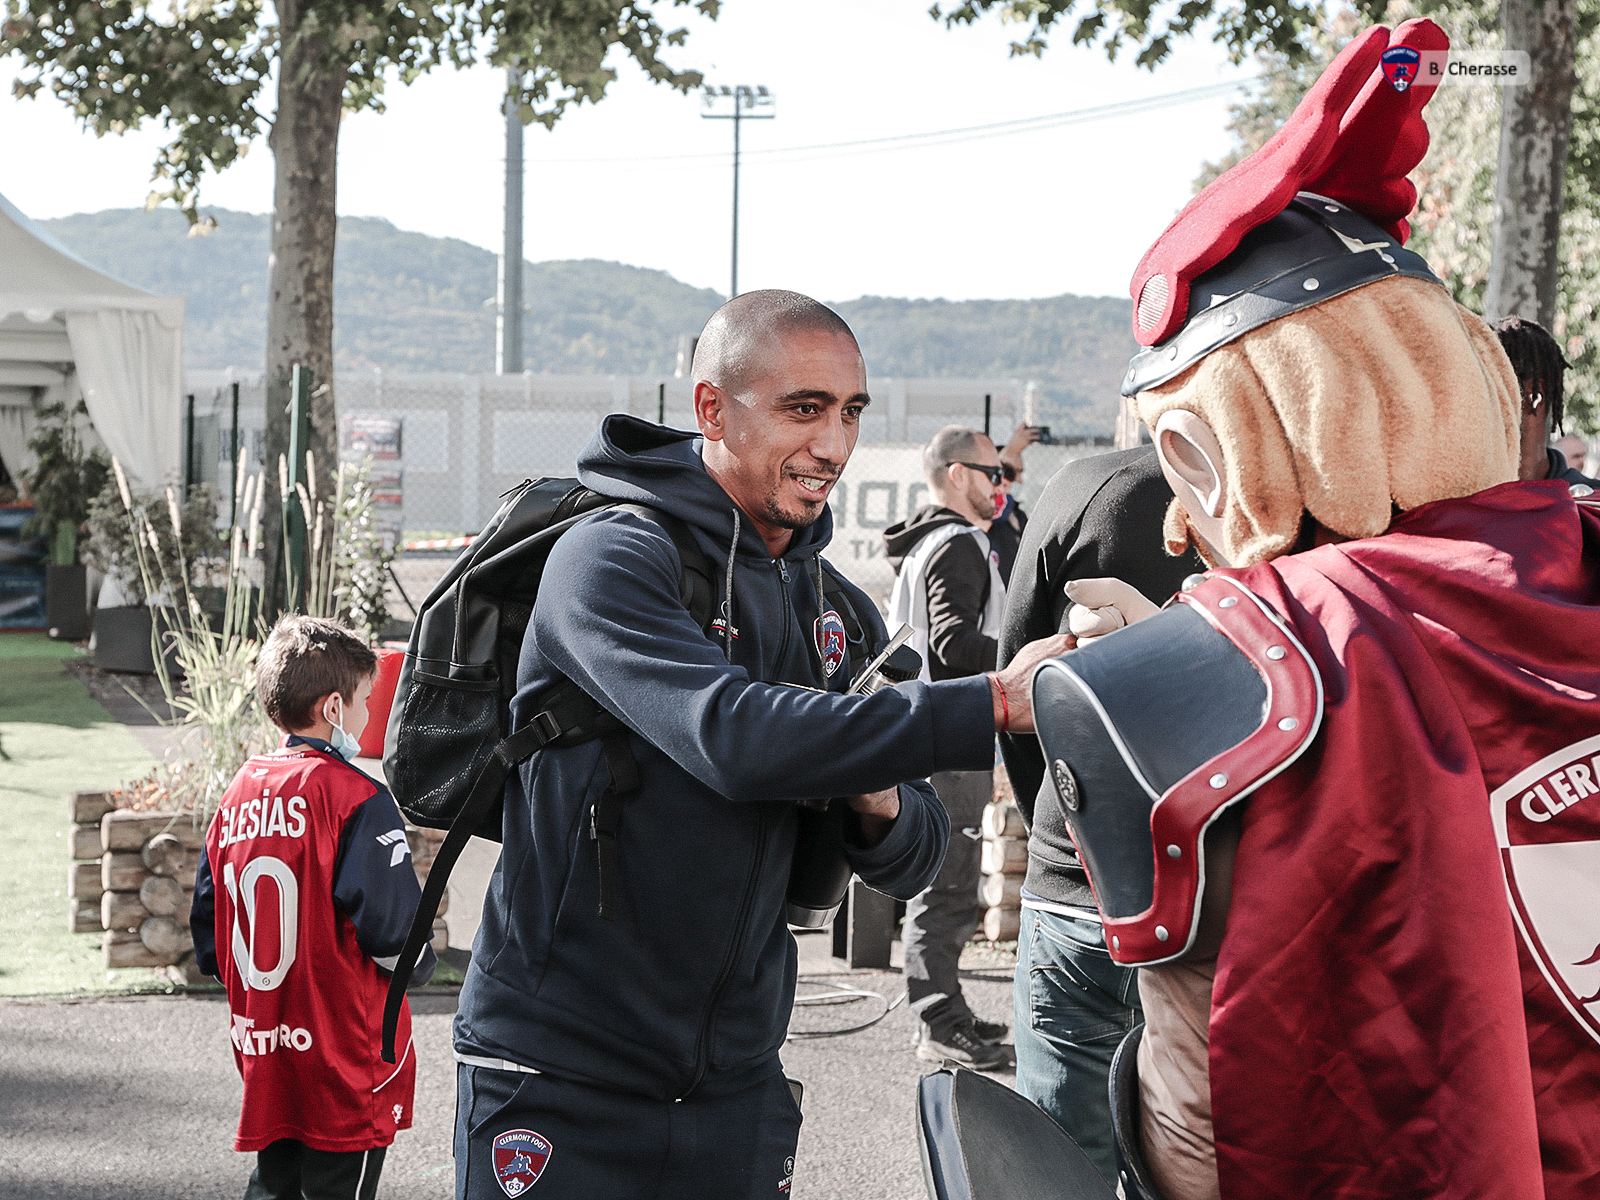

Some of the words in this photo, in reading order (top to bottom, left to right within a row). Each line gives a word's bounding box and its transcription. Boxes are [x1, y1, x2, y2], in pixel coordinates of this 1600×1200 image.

[1520, 754, 1600, 823] CLER
[223, 855, 299, 991] 10
[499, 1134, 531, 1146] CLERMONT
[530, 1137, 547, 1150] FOOT
[508, 1183, 521, 1191] 63
